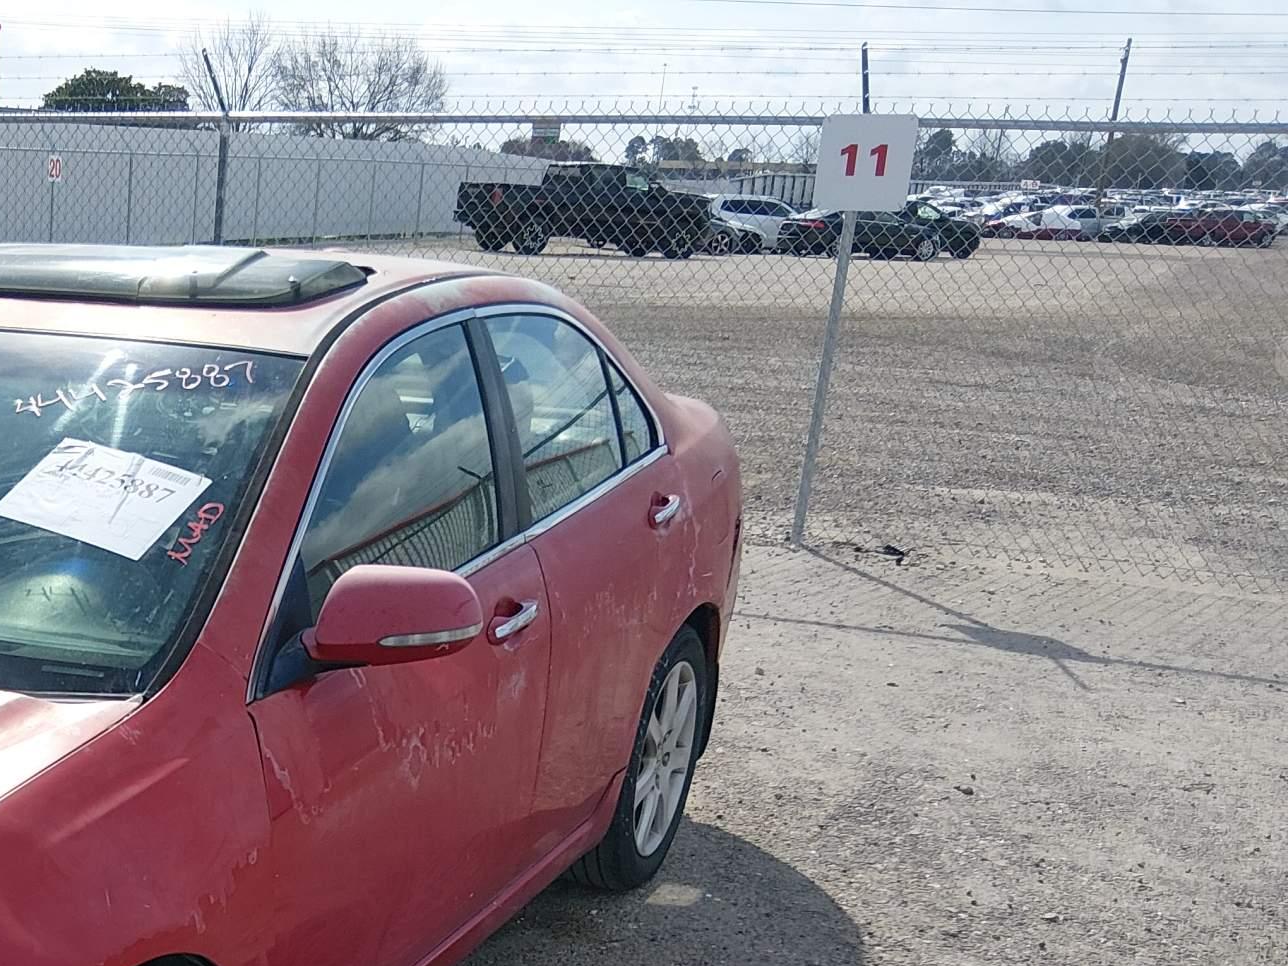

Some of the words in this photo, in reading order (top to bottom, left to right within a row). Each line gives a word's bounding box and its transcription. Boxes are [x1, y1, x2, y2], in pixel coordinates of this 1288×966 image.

[49, 158, 61, 178] 20
[843, 144, 888, 176] 11
[15, 360, 254, 417] 44425887
